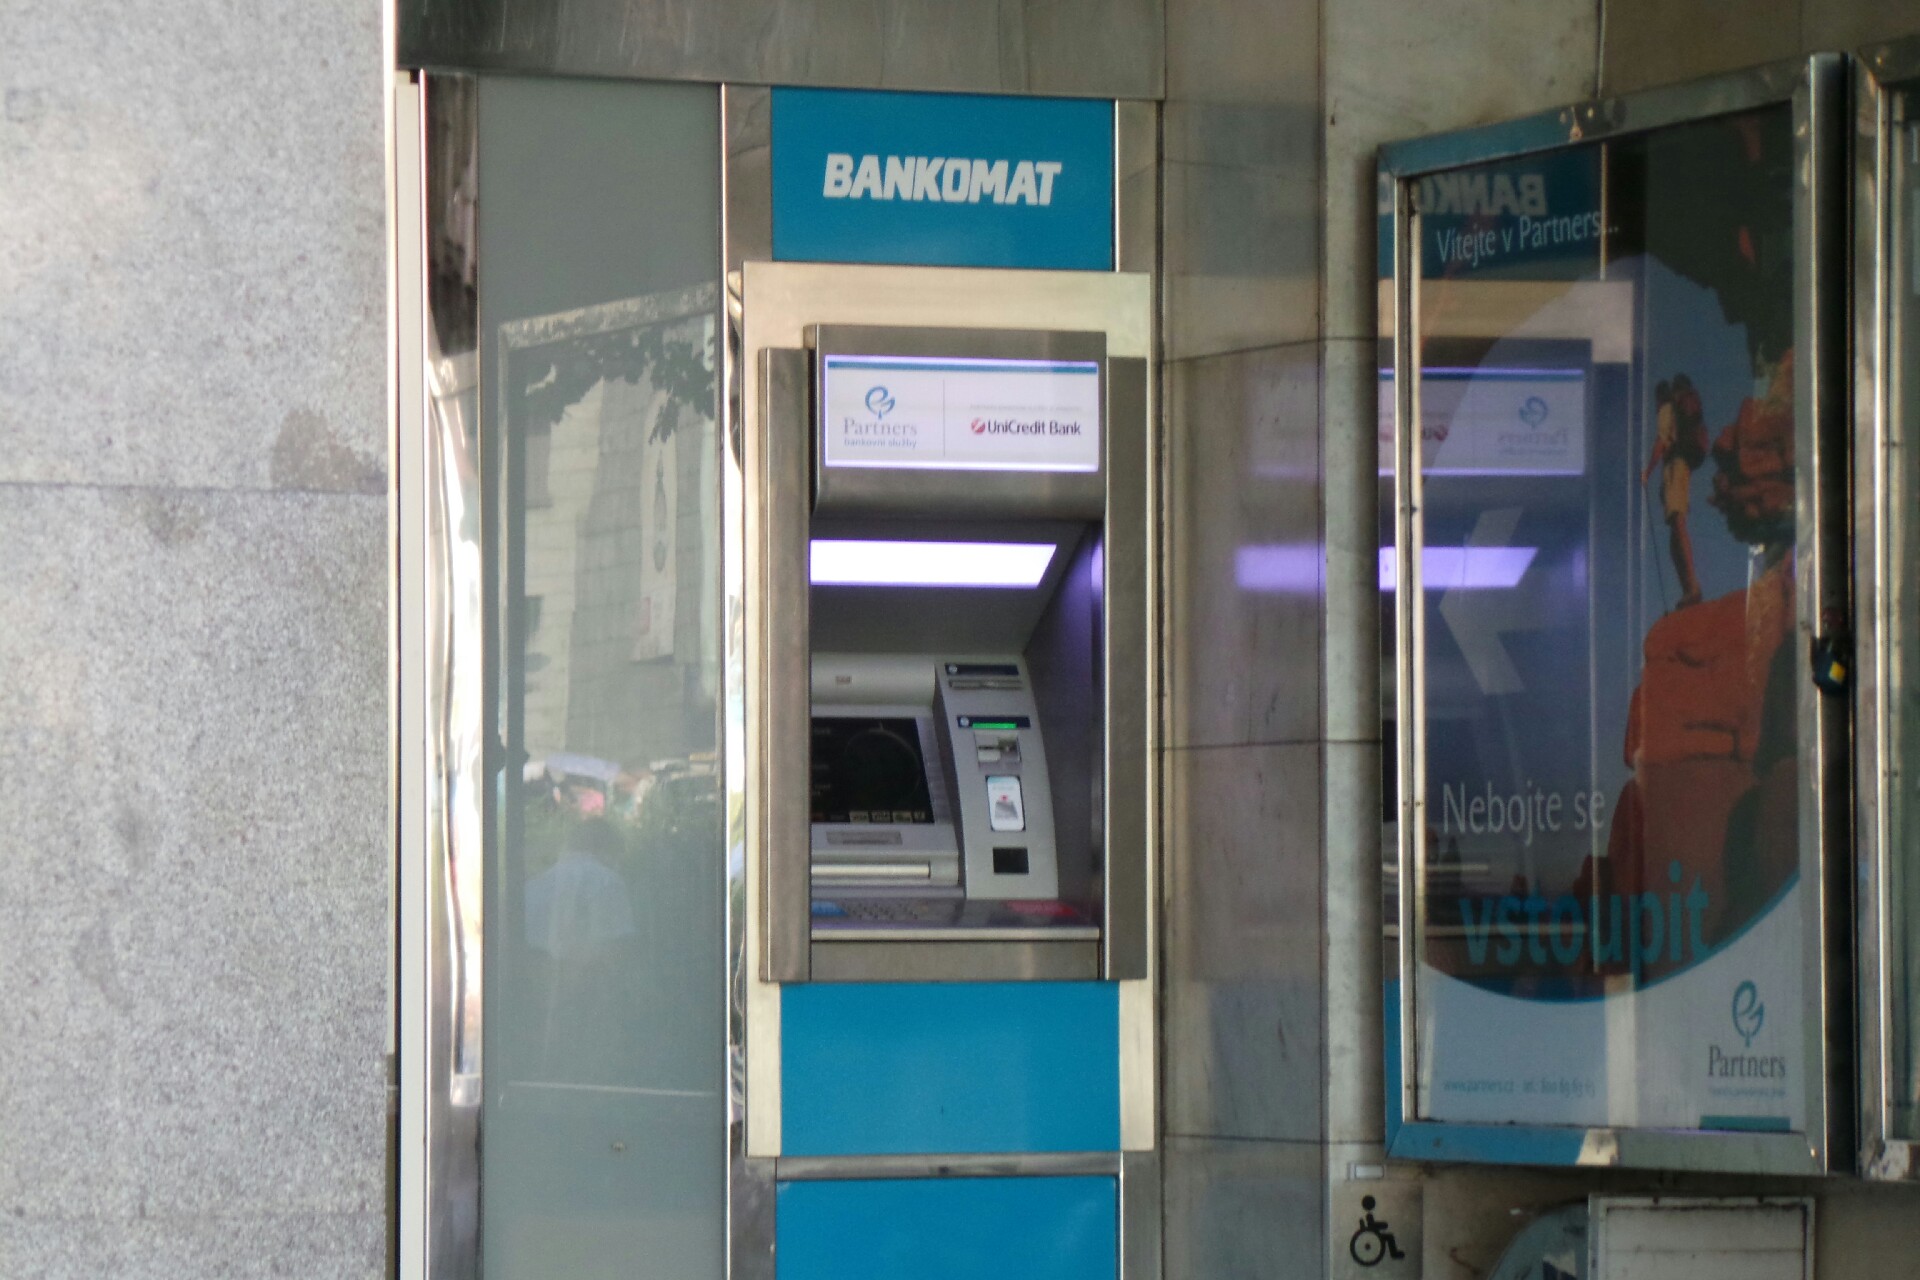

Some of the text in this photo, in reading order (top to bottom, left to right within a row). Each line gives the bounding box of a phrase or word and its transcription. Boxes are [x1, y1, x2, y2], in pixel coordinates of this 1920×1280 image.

[823, 153, 1062, 206] BANKOMAT
[1437, 223, 1496, 268] Vítejte
[1502, 227, 1513, 252] v
[844, 417, 917, 435] Partners
[987, 419, 1081, 436] UniCredit Bank
[1442, 779, 1605, 846] Nebojte se
[1458, 859, 1710, 980] vstoupit
[1709, 1044, 1786, 1078] Partners
